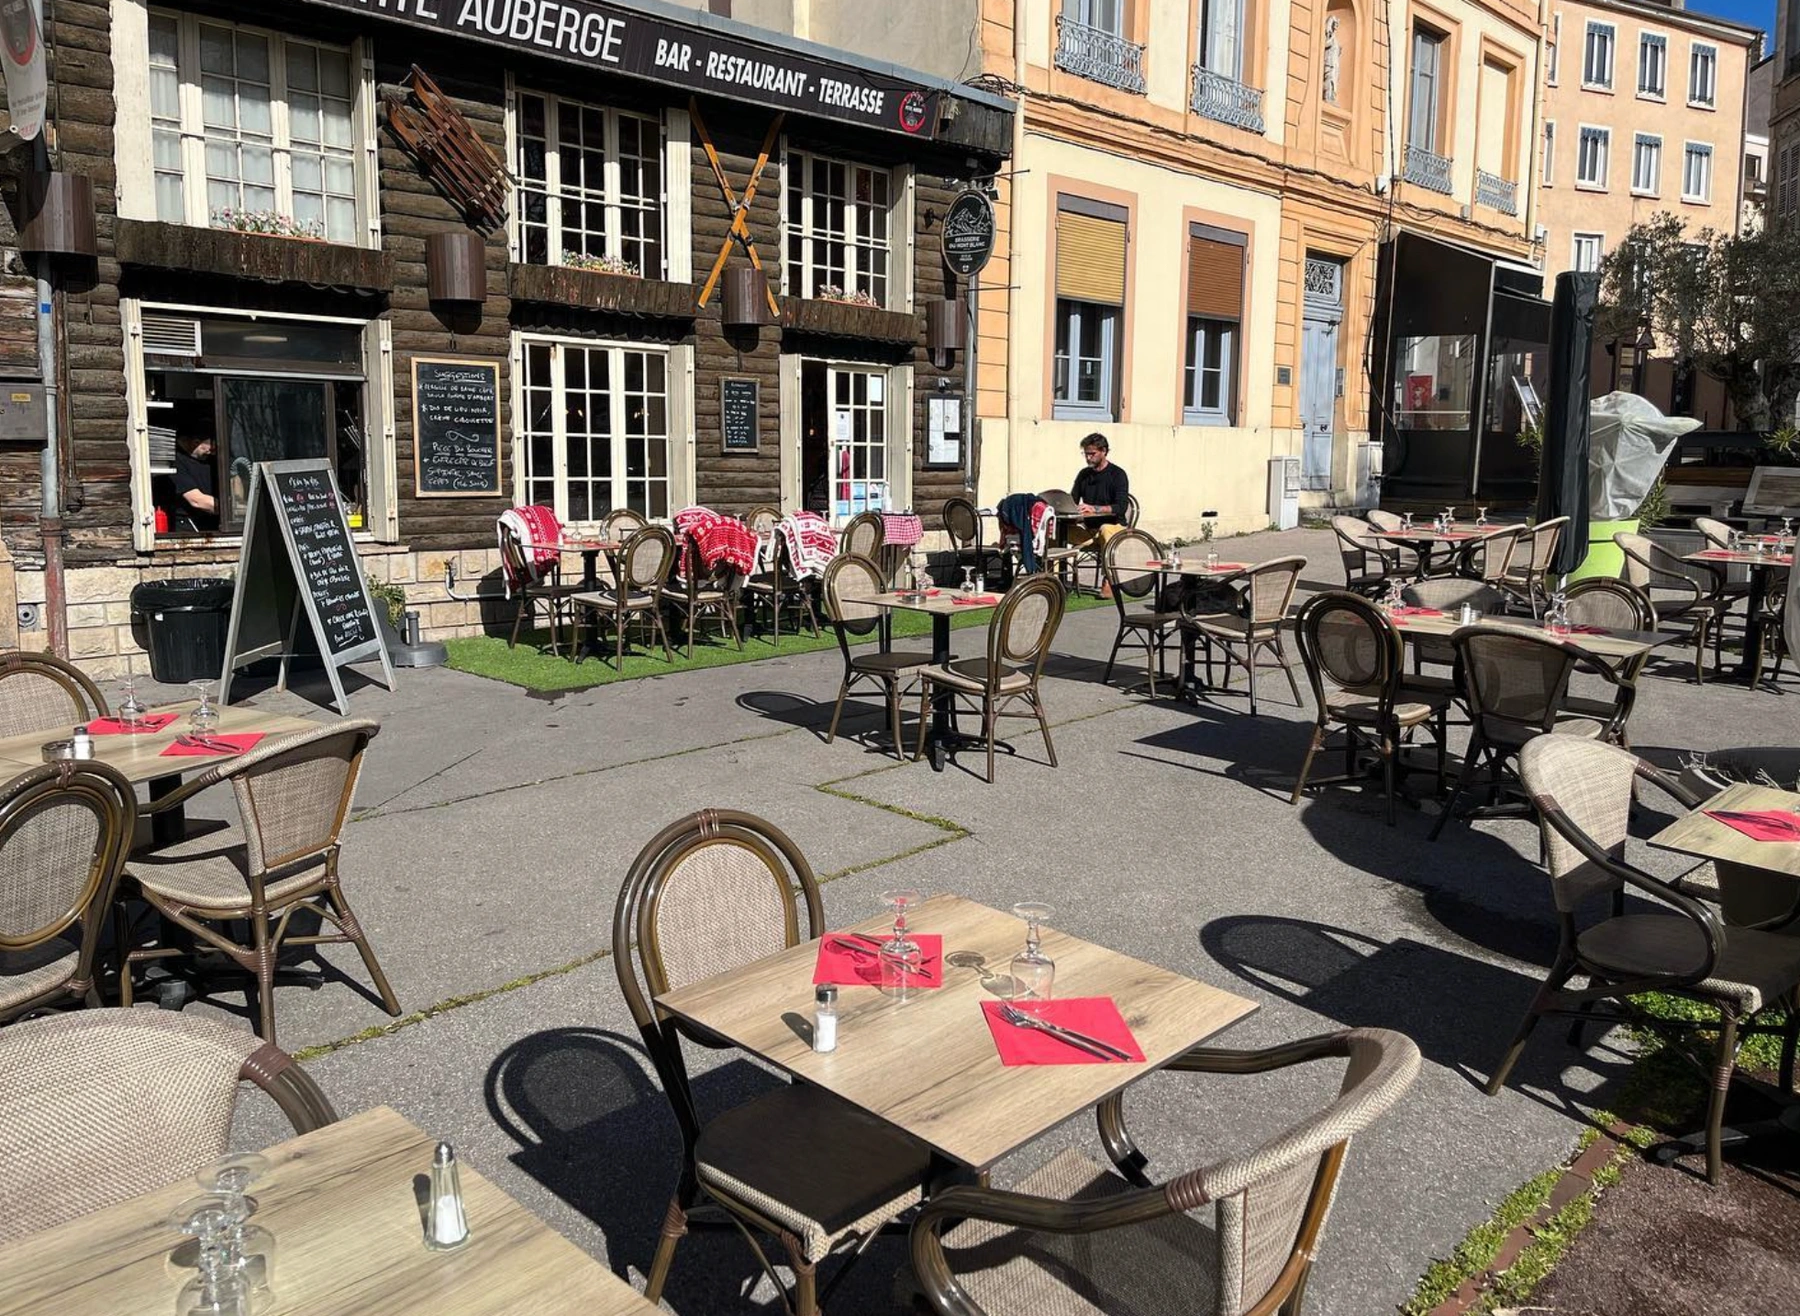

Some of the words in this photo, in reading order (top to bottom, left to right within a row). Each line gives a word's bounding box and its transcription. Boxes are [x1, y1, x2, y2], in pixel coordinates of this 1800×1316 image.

[457, 0, 626, 62] AUBERGE
[655, 38, 691, 72] BAR
[705, 51, 807, 97] RESTAURANT
[818, 78, 885, 115] TERRASSE
